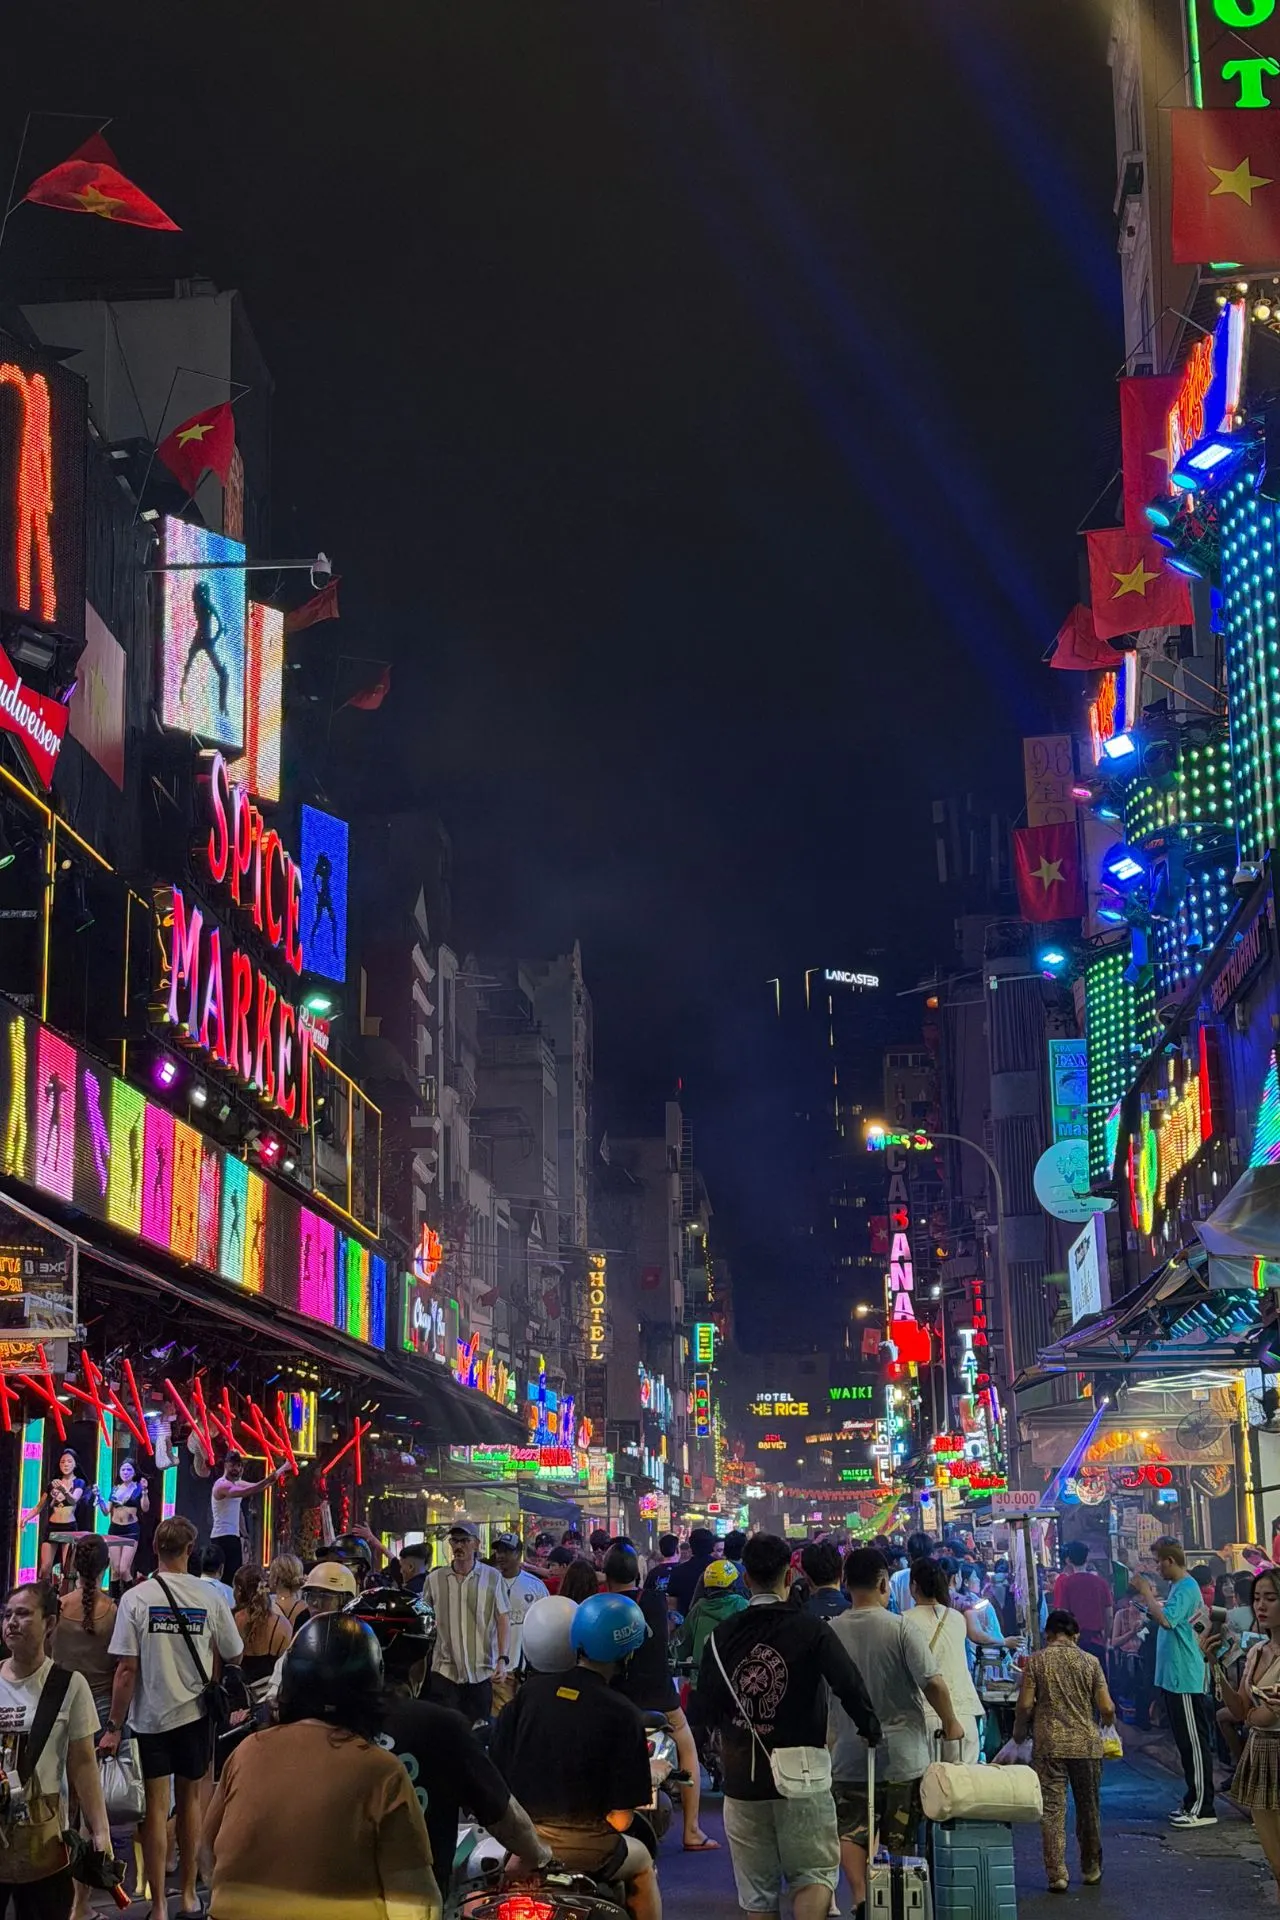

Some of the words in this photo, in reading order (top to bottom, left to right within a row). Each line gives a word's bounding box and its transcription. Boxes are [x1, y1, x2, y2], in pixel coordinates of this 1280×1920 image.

[208, 750, 303, 975] SPICE
[825, 969, 879, 987] LANCASTER
[168, 883, 314, 1132] MARKET
[886, 1147, 915, 1320] CABANA
[589, 1271, 606, 1360] HOTEL
[971, 1280, 988, 1346] TINA
[756, 1393, 795, 1402] HOTEL
[774, 1402, 810, 1416] RICE
[829, 1386, 873, 1400] WAIKI
[878, 1421, 890, 1482] HOEL
[996, 1492, 1036, 1505] 30.000
[152, 1622, 201, 1633] patagnia
